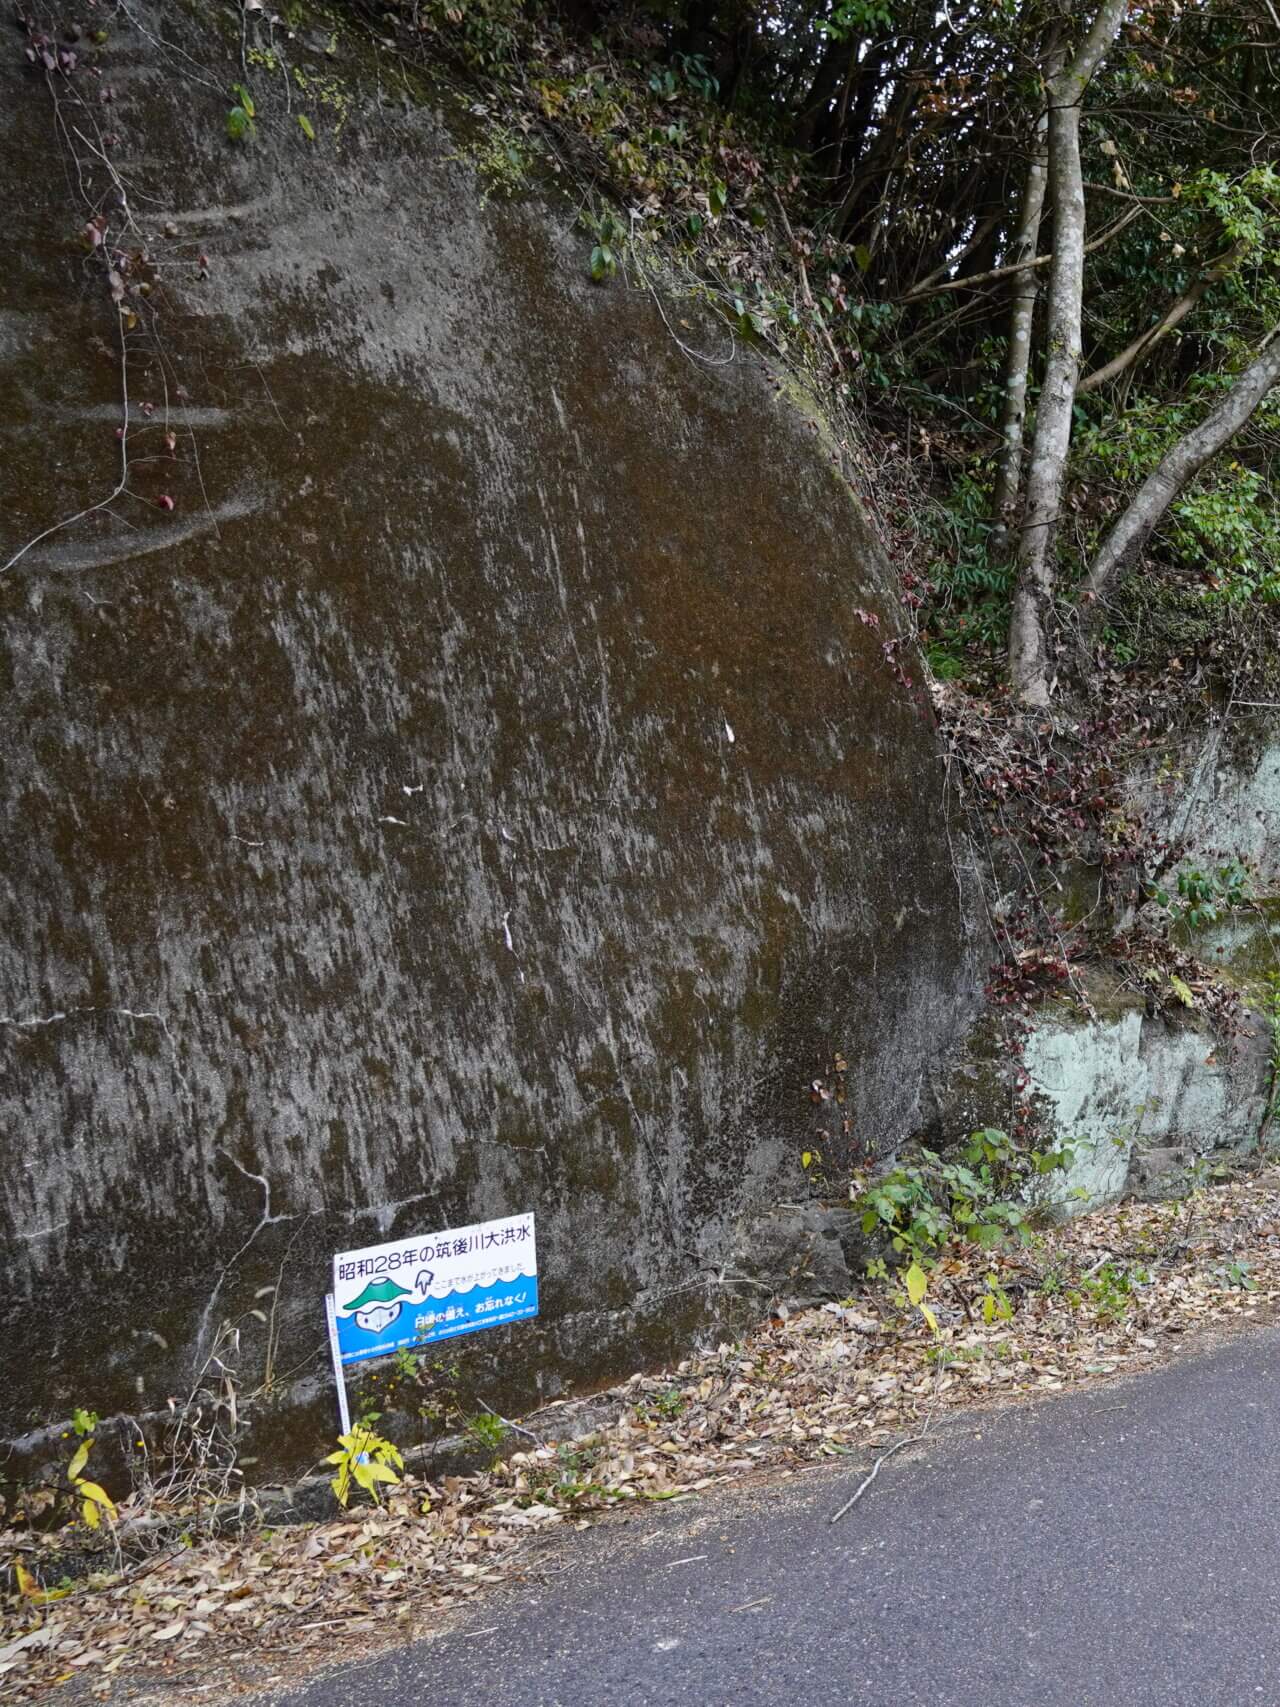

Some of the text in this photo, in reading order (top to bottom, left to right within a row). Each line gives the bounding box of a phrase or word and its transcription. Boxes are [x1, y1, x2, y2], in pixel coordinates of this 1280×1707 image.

[338, 1224, 532, 1281] 昭和28年の筑後川大洪水
